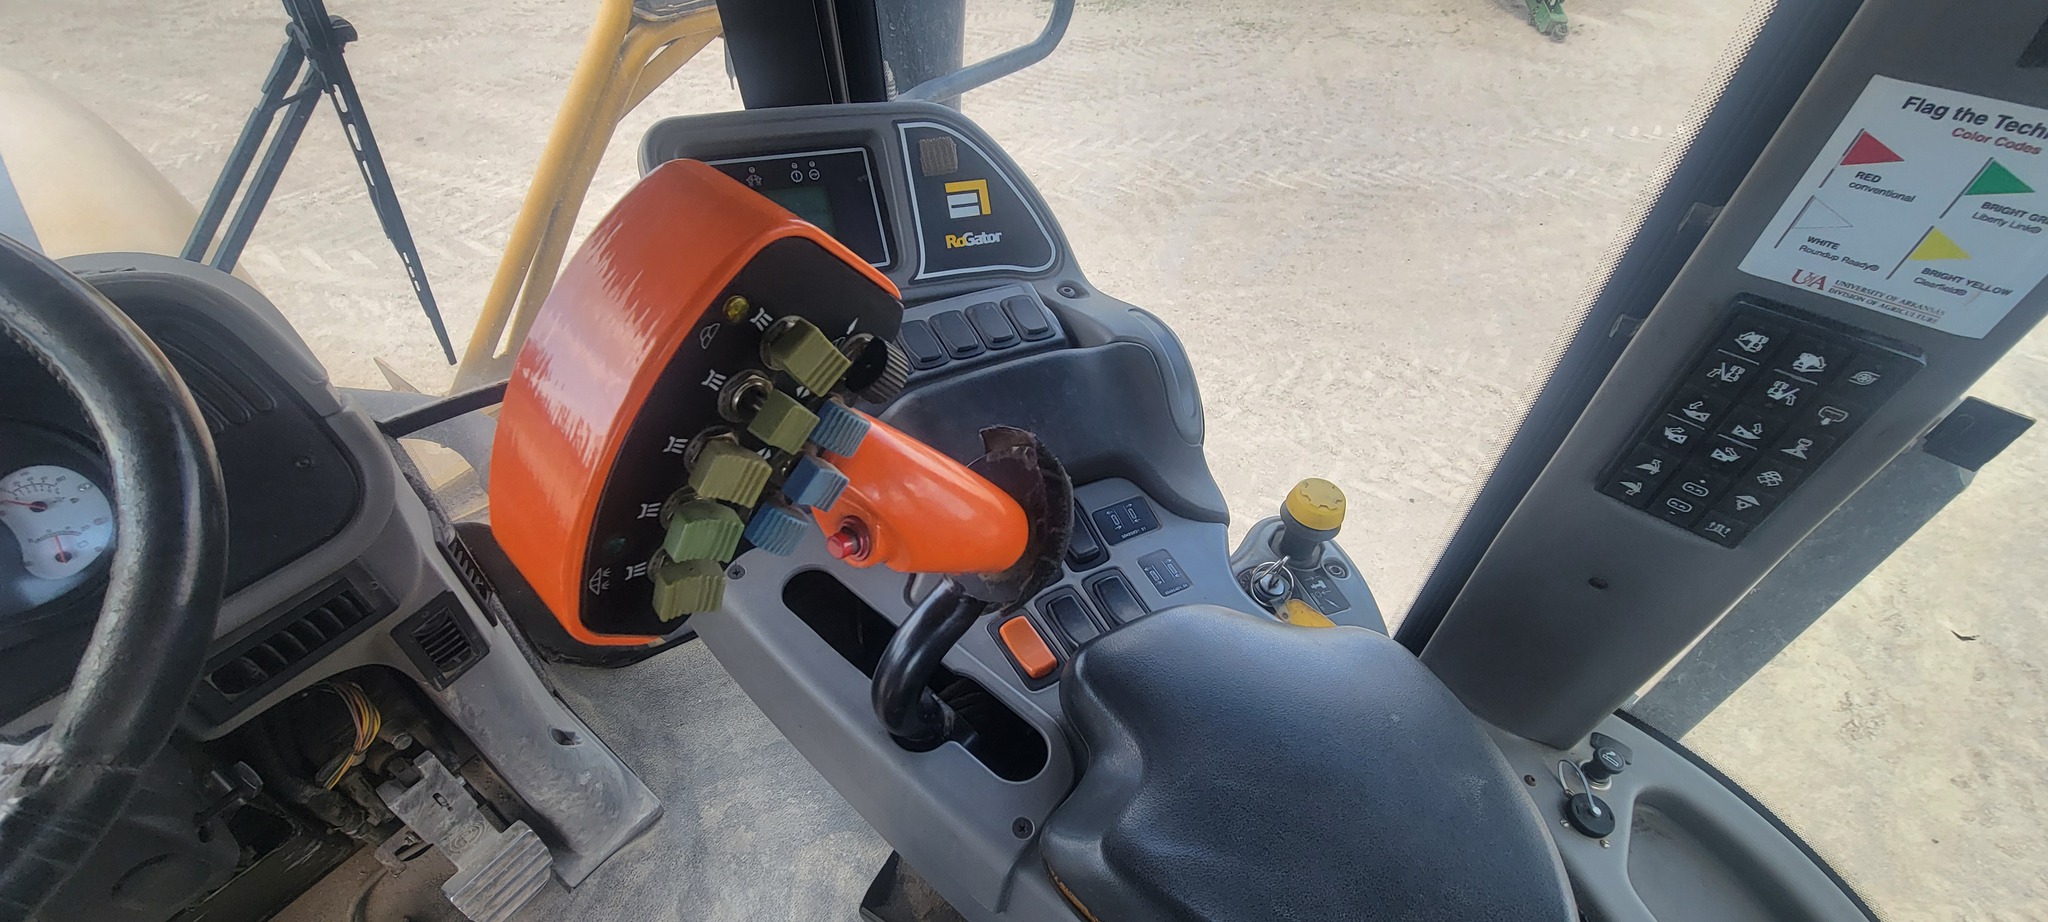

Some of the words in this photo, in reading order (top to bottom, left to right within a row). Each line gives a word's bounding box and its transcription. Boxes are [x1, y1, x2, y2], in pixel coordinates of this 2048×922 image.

[1901, 96, 1950, 121] Flag
[1952, 107, 1989, 126] the
[1951, 127, 1992, 144] Color
[1994, 136, 2043, 155] Codes
[1854, 171, 1882, 183] RED
[1848, 181, 1916, 203] conventional
[1971, 211, 2008, 228] Liberty
[1981, 201, 2029, 218] BRIGHT
[945, 231, 1003, 249] RoGator
[1807, 235, 1841, 251] WHITE
[1798, 244, 1839, 261] Roundup
[1920, 267, 1966, 284] BRIGHT
[1965, 279, 2014, 296] YELLOW
[1828, 287, 1865, 303] DIVISION
[1865, 298, 1879, 307] OF
[1878, 302, 1940, 325] AGRICULTURE
[1834, 279, 1885, 299] UNIVERSITY
[1885, 293, 1900, 304] OF
[1900, 298, 1945, 316] ARKANSAS
